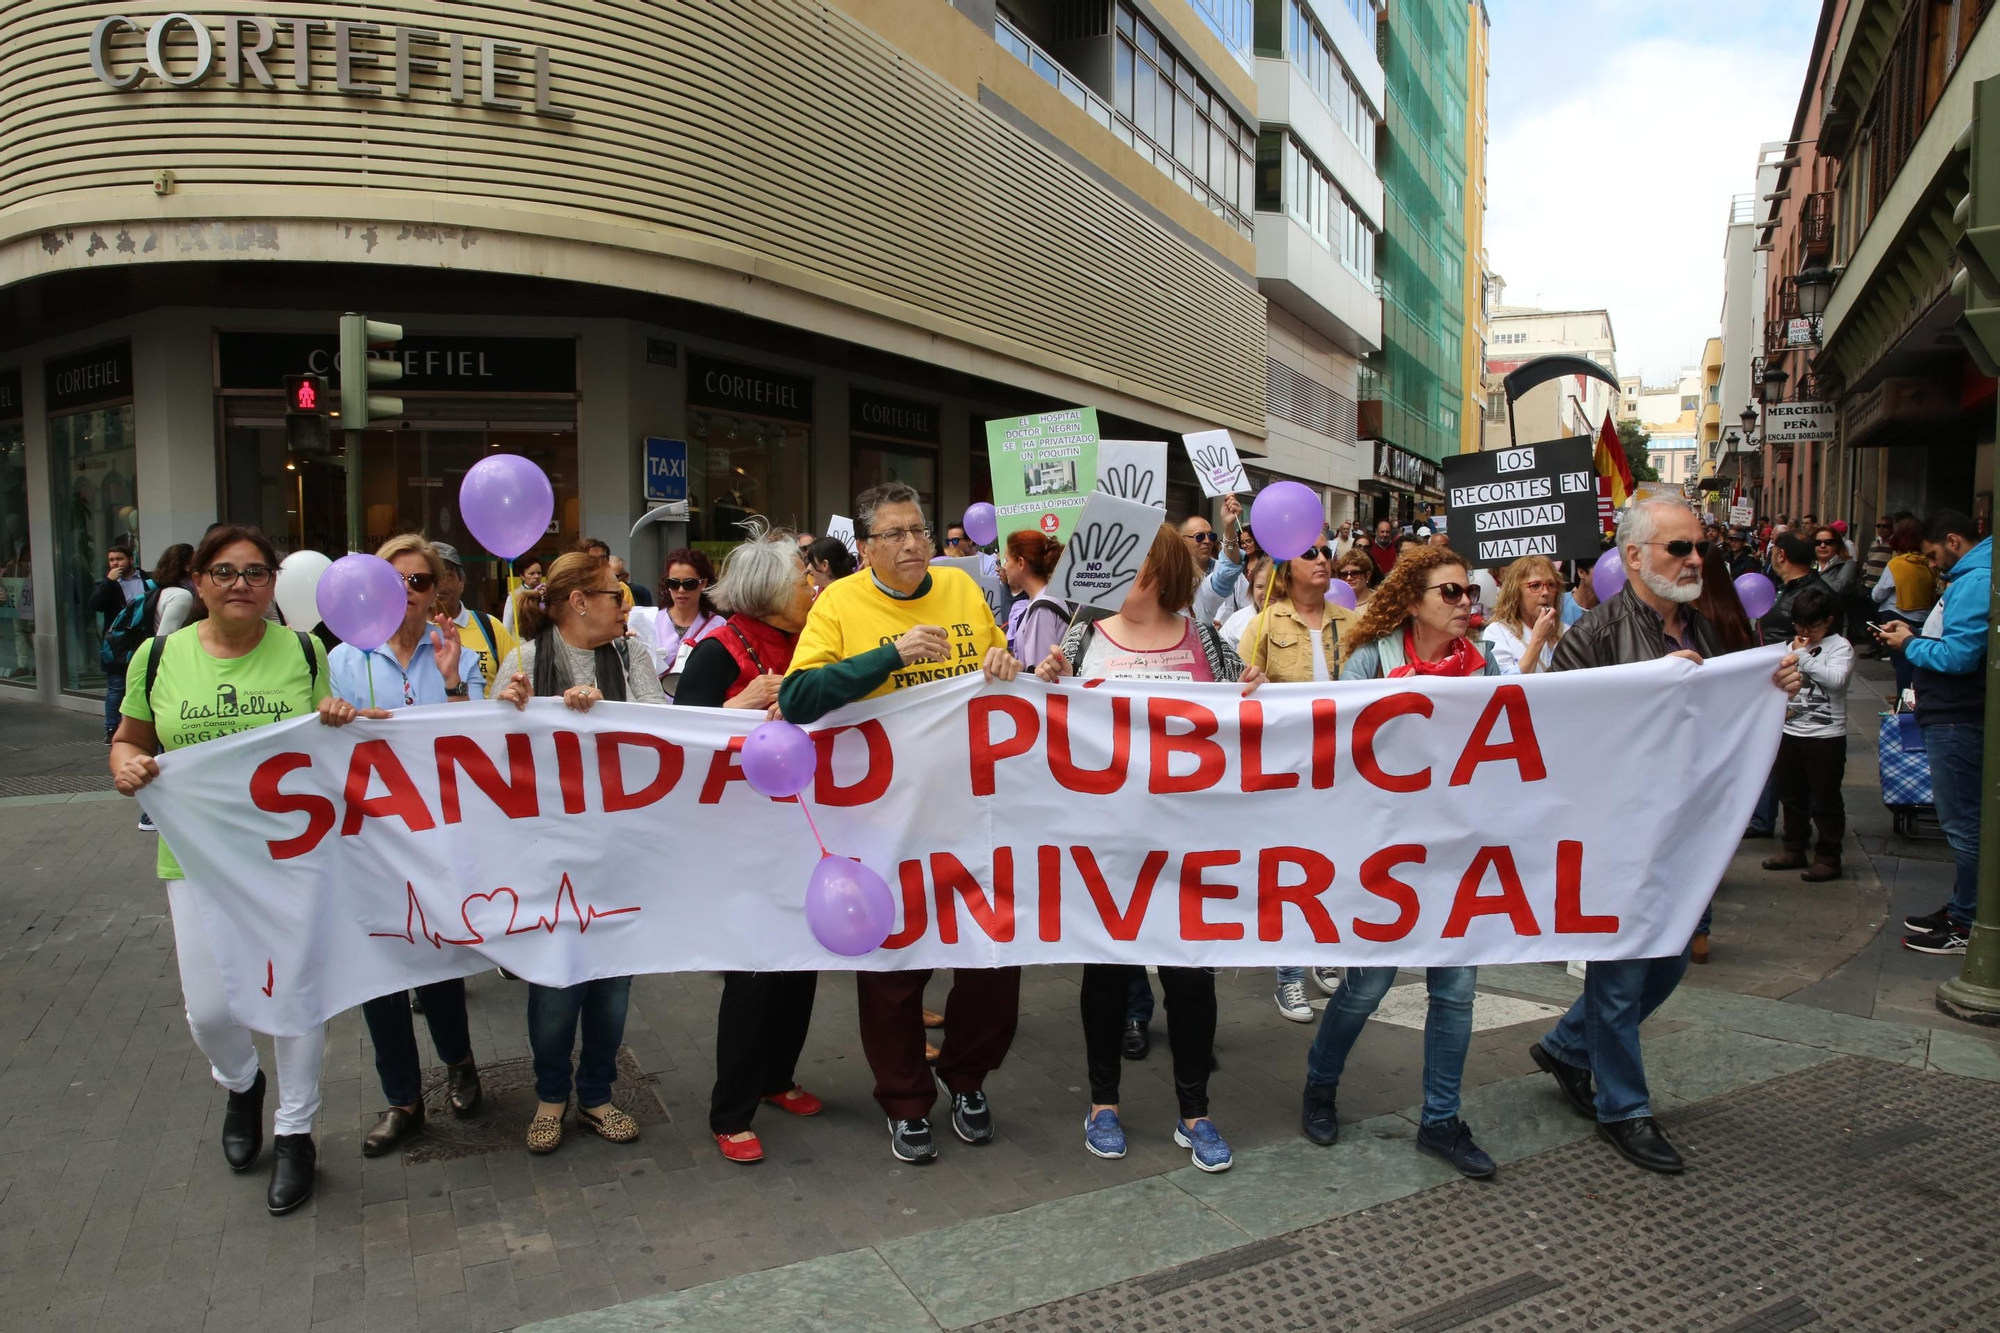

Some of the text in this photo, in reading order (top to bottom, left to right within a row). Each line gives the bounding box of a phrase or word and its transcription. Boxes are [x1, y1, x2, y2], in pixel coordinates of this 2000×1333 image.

[90, 13, 576, 120] CORTEFIEL
[308, 350, 493, 376] CTEFIEL
[56, 360, 120, 395] CORTEFIEL
[705, 371, 798, 408] CORTEFIEL
[862, 402, 929, 432] CORTEFIEL
[1019, 412, 1080, 426] EL HOSPITAL
[1767, 404, 1834, 416] MERCERÍA
[1006, 423, 1080, 439] DOCTOR NEGRIN
[1783, 418, 1818, 430] PEÑA
[1023, 440, 1035, 448] HA
[1039, 434, 1095, 447] PRIVATIZADO
[1767, 431, 1833, 441] ENCAJES BORDADOS
[1021, 448, 1080, 460] UN POQUITIN
[1499, 450, 1533, 471] LOS
[649, 457, 685, 478] TAXI
[1453, 479, 1551, 506] RECORTES
[1562, 473, 1588, 492] EN
[996, 505, 1018, 516] ¿QUÉ
[1020, 502, 1041, 513] SERÁ
[1043, 500, 1054, 509] LO
[1476, 505, 1564, 530] SANIDAD
[1481, 536, 1555, 559] MATAN
[1086, 562, 1102, 571] NO
[952, 623, 973, 638] TE
[956, 642, 978, 658] LA
[893, 659, 979, 689] PENSIÓN
[180, 700, 215, 720] las
[203, 720, 236, 728] Canaria
[968, 679, 1547, 796] PÚBLICA
